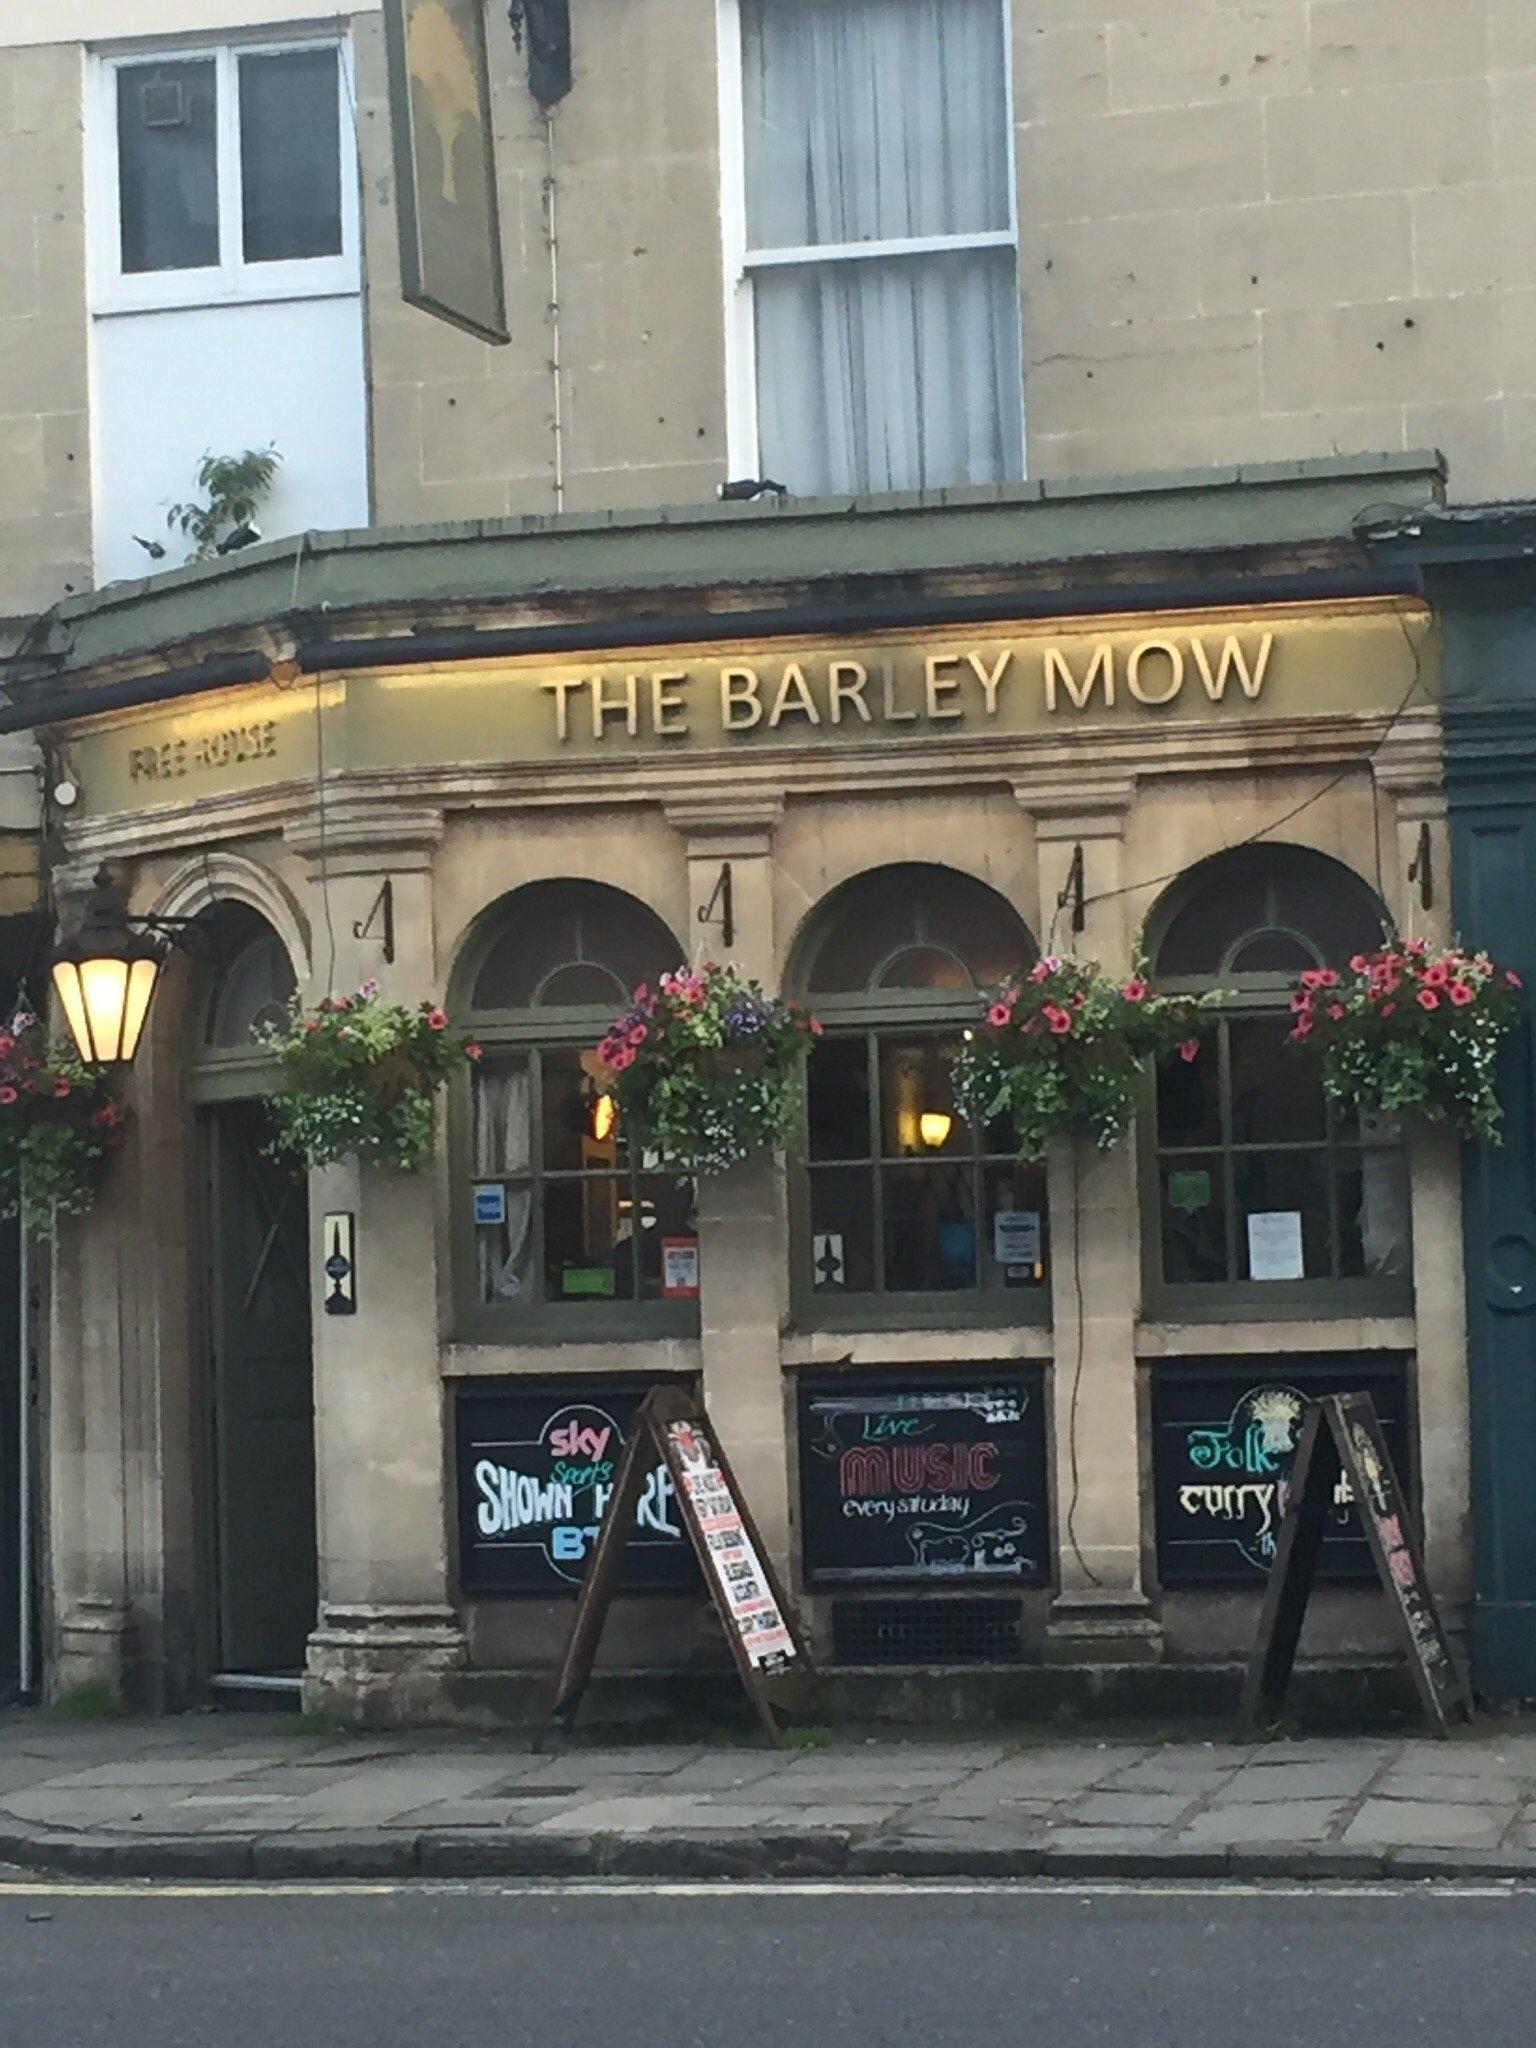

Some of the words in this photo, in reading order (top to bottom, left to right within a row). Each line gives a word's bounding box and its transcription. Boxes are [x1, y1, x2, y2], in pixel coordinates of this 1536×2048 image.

[542, 671, 691, 740] THE
[718, 649, 1013, 733] BARLEY
[1041, 633, 1276, 714] MOW
[550, 1420, 611, 1462] sky
[862, 1414, 930, 1442] Live
[1188, 1423, 1280, 1473] Folk
[475, 1459, 573, 1536] SHOWN
[1178, 1483, 1275, 1537] curry
